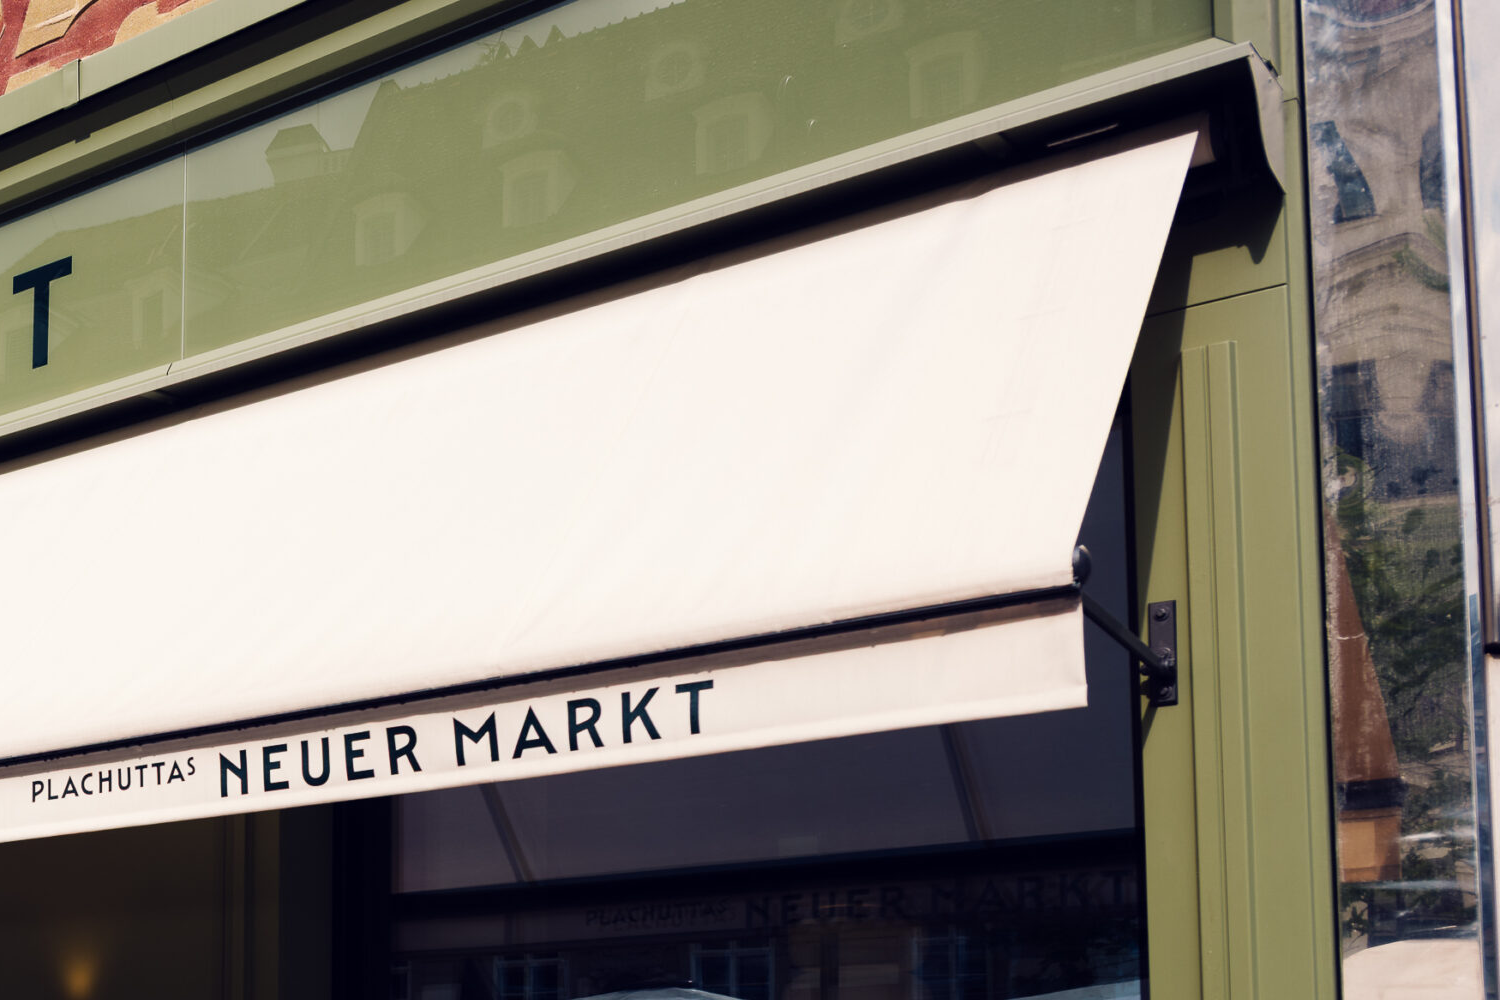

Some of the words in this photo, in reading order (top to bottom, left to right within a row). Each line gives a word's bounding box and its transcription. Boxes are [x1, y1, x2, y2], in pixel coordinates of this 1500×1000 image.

[31, 756, 197, 803] PLACHUTTAS
[219, 724, 423, 798] NEUER
[453, 679, 715, 768] MARKT
